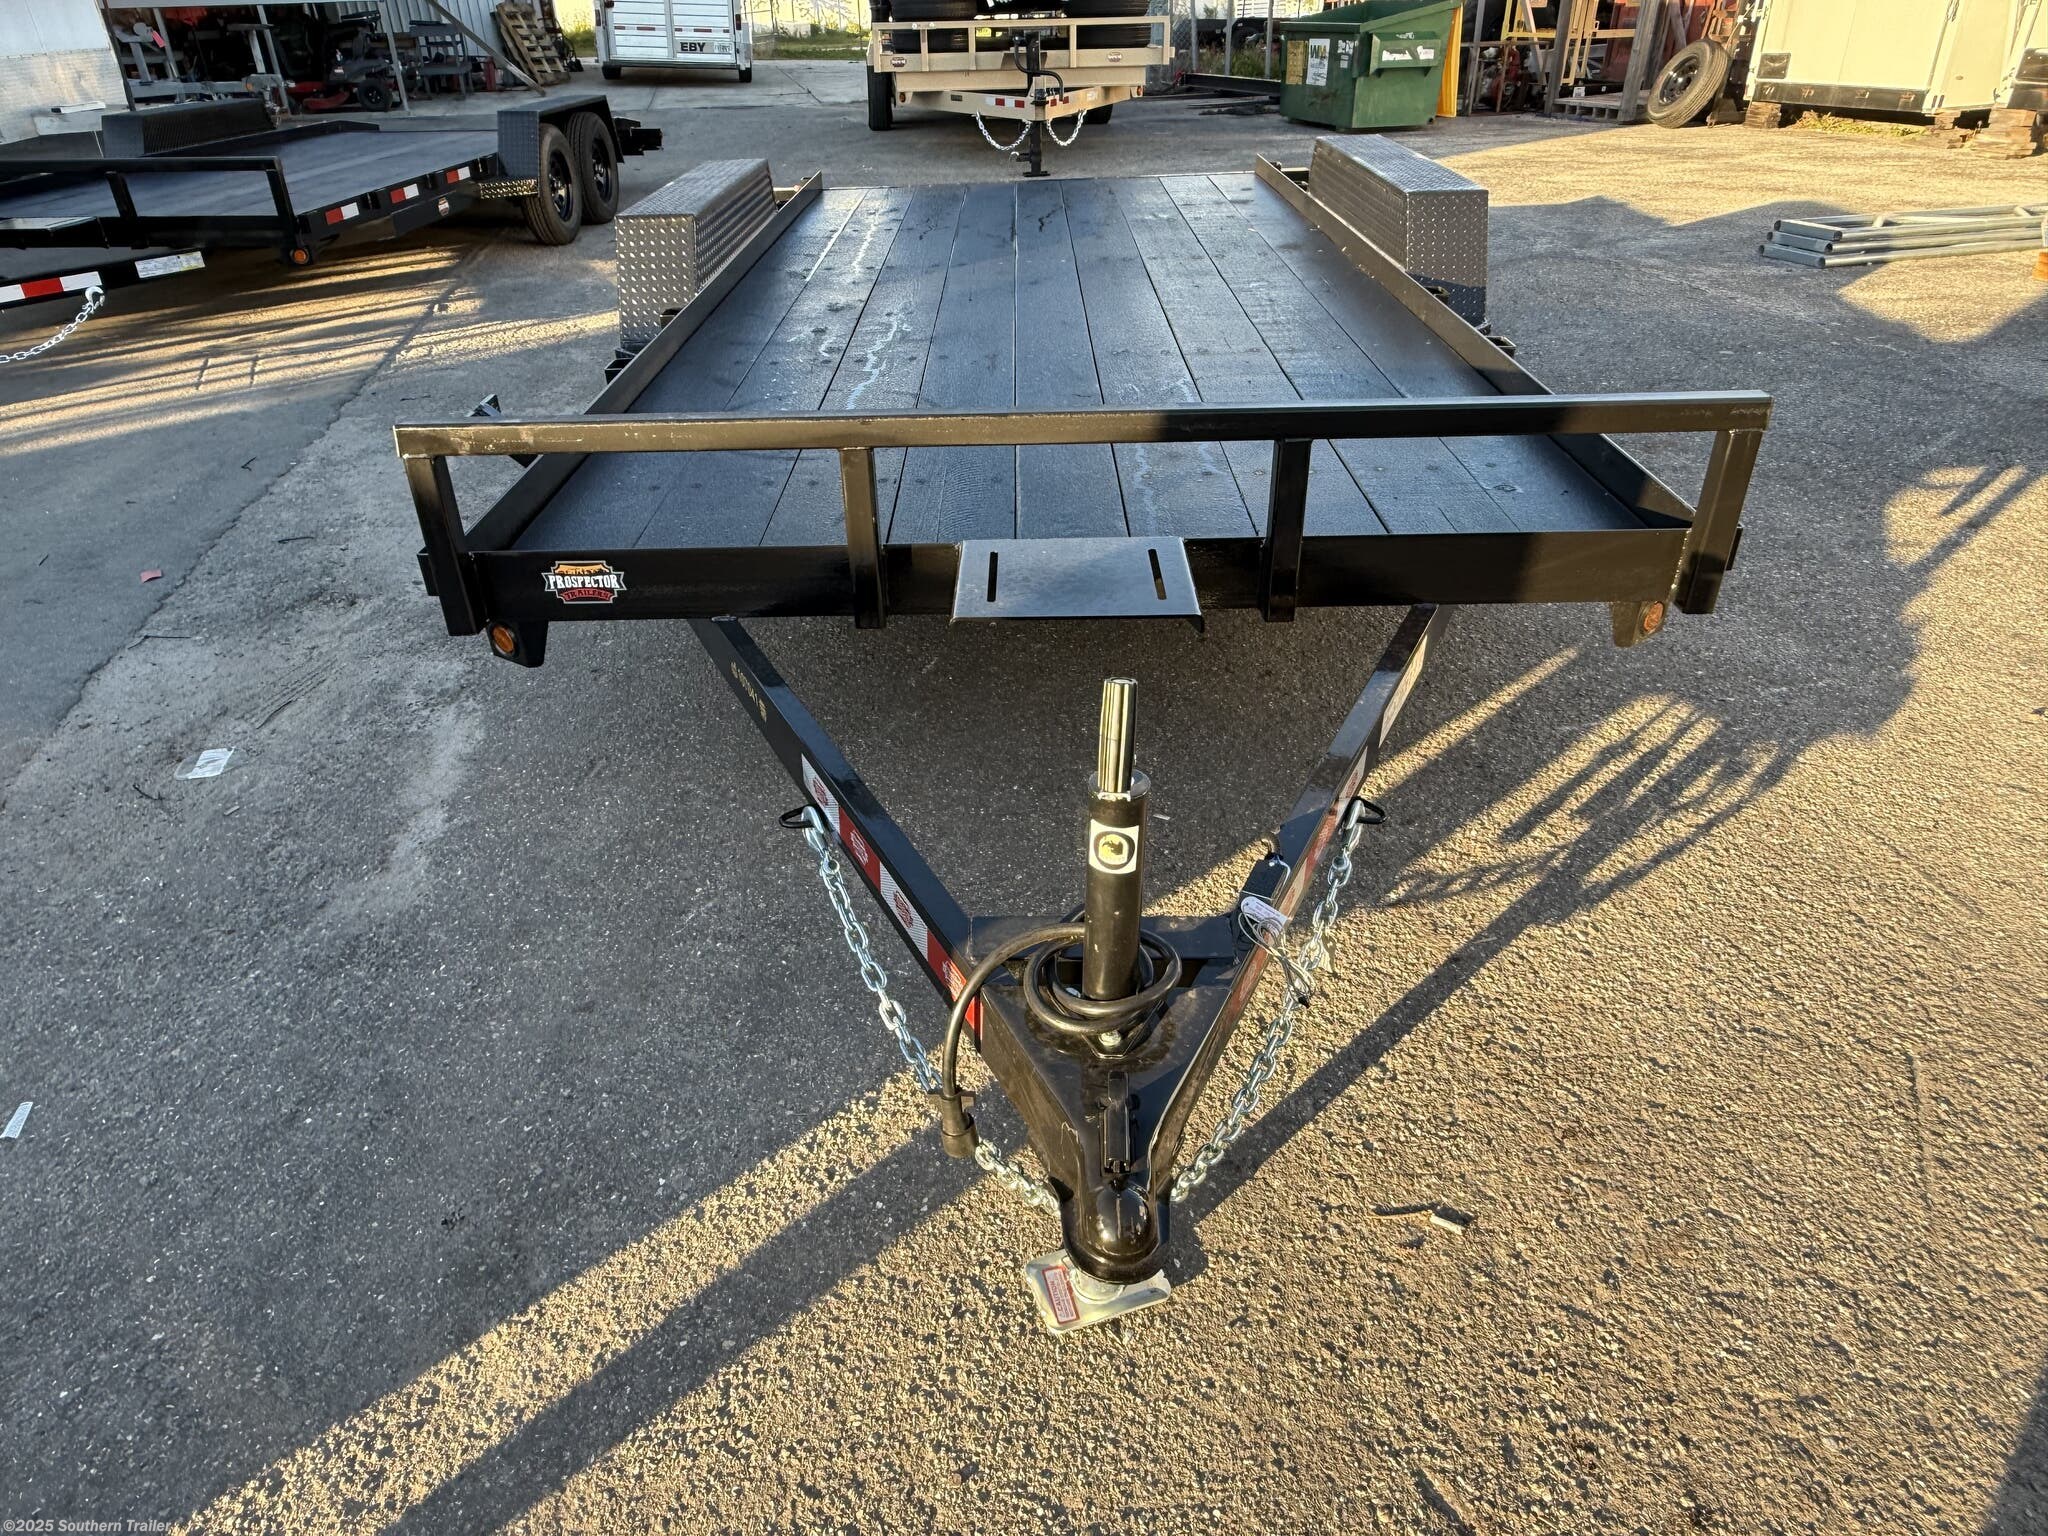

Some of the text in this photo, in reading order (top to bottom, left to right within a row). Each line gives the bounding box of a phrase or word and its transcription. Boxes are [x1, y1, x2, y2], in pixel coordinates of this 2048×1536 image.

[680, 42, 706, 52] EBY
[1310, 44, 1327, 59] WM
[548, 574, 620, 590] PROSPECTOR
[564, 590, 610, 600] TRAILERS
